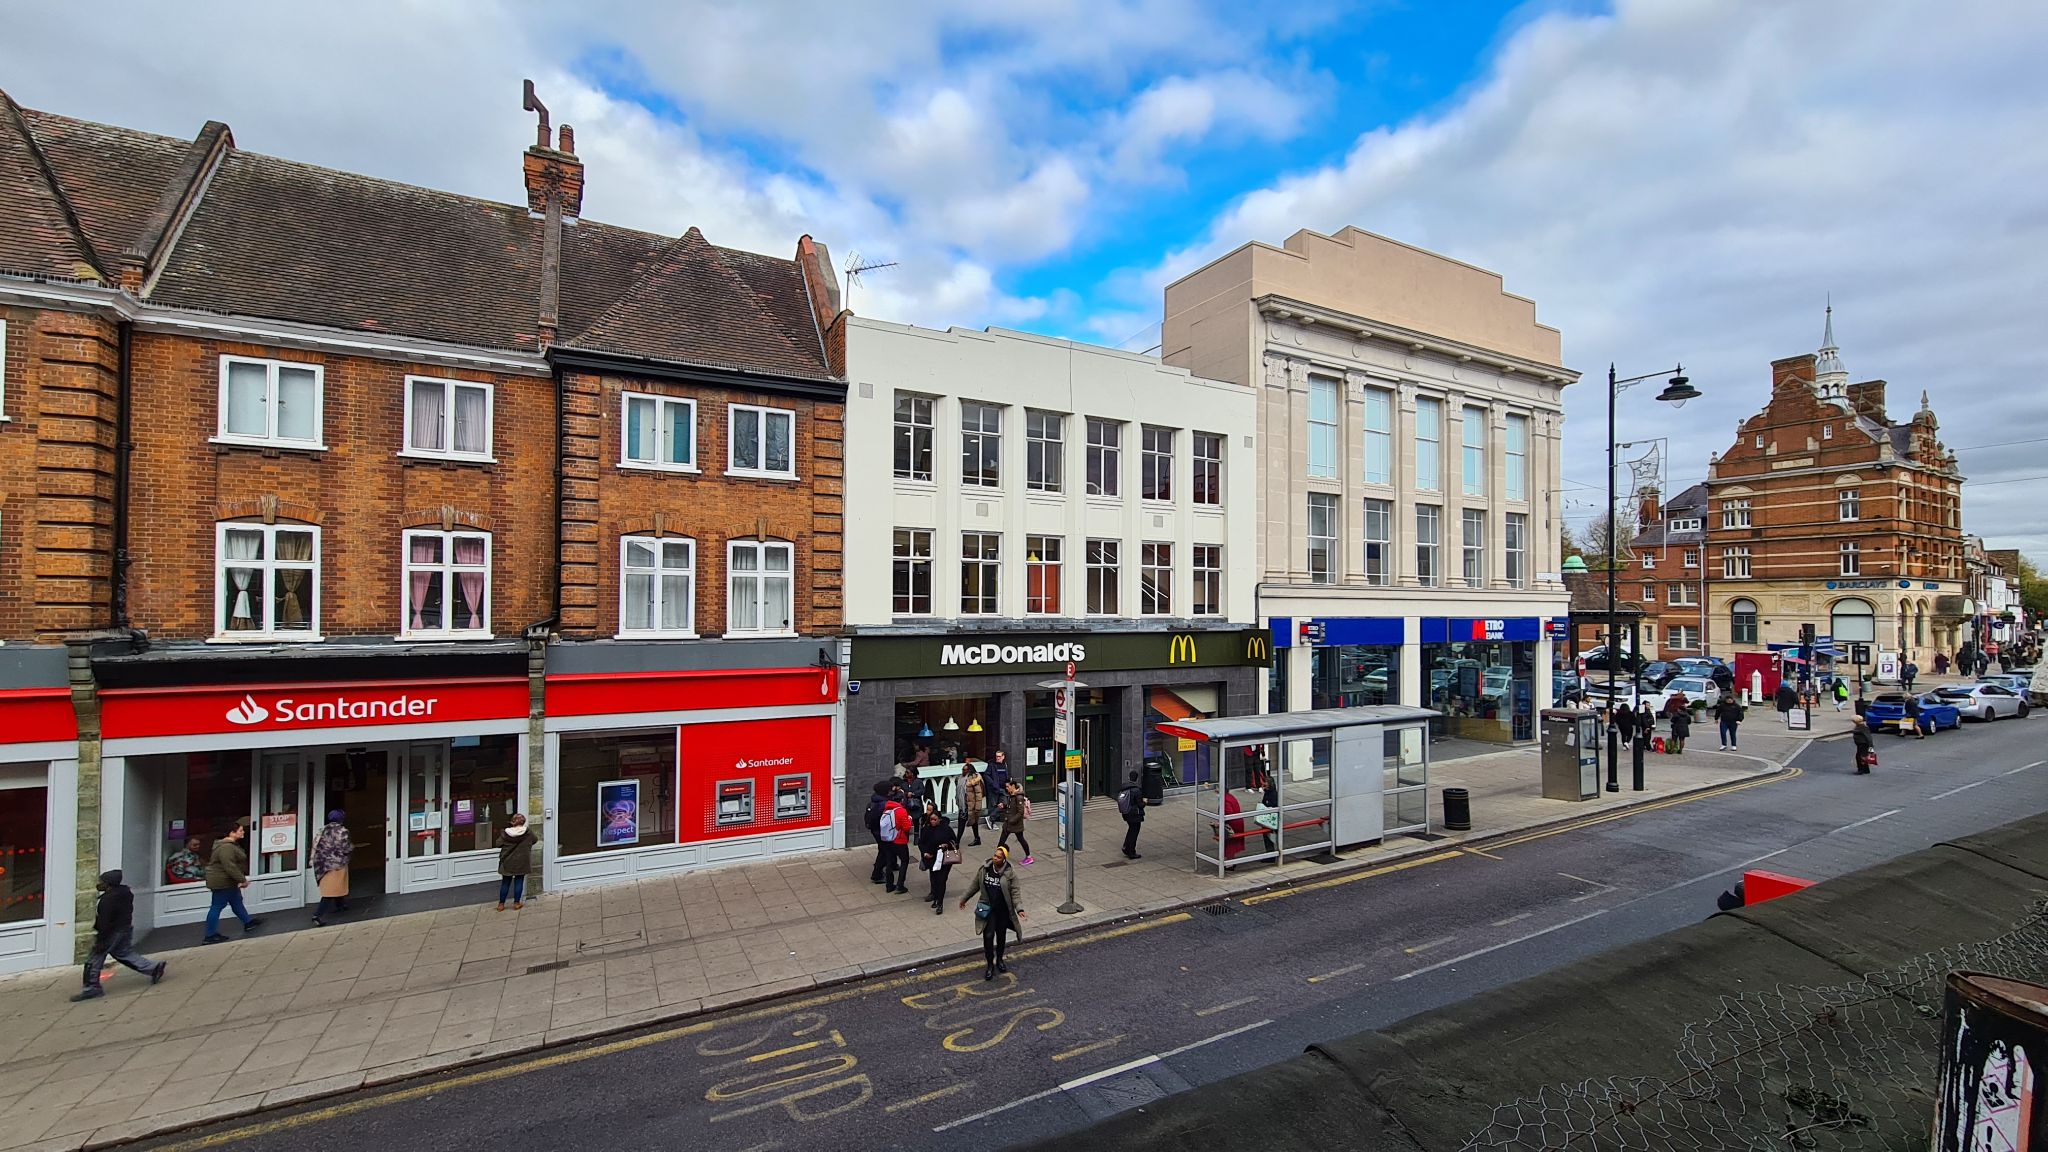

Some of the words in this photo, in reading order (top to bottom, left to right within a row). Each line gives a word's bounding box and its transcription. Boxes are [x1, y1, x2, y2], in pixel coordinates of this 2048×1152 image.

[1838, 581, 1888, 589] BARCLAYS
[1472, 619, 1504, 640] METRO
[1486, 632, 1504, 640] BANK
[941, 643, 1086, 665] McDonald's
[1067, 664, 1073, 676] E
[275, 695, 438, 722] Santander
[747, 757, 794, 768] Santander
[900, 971, 1065, 1052] BUS
[695, 1011, 873, 1122] STOP
